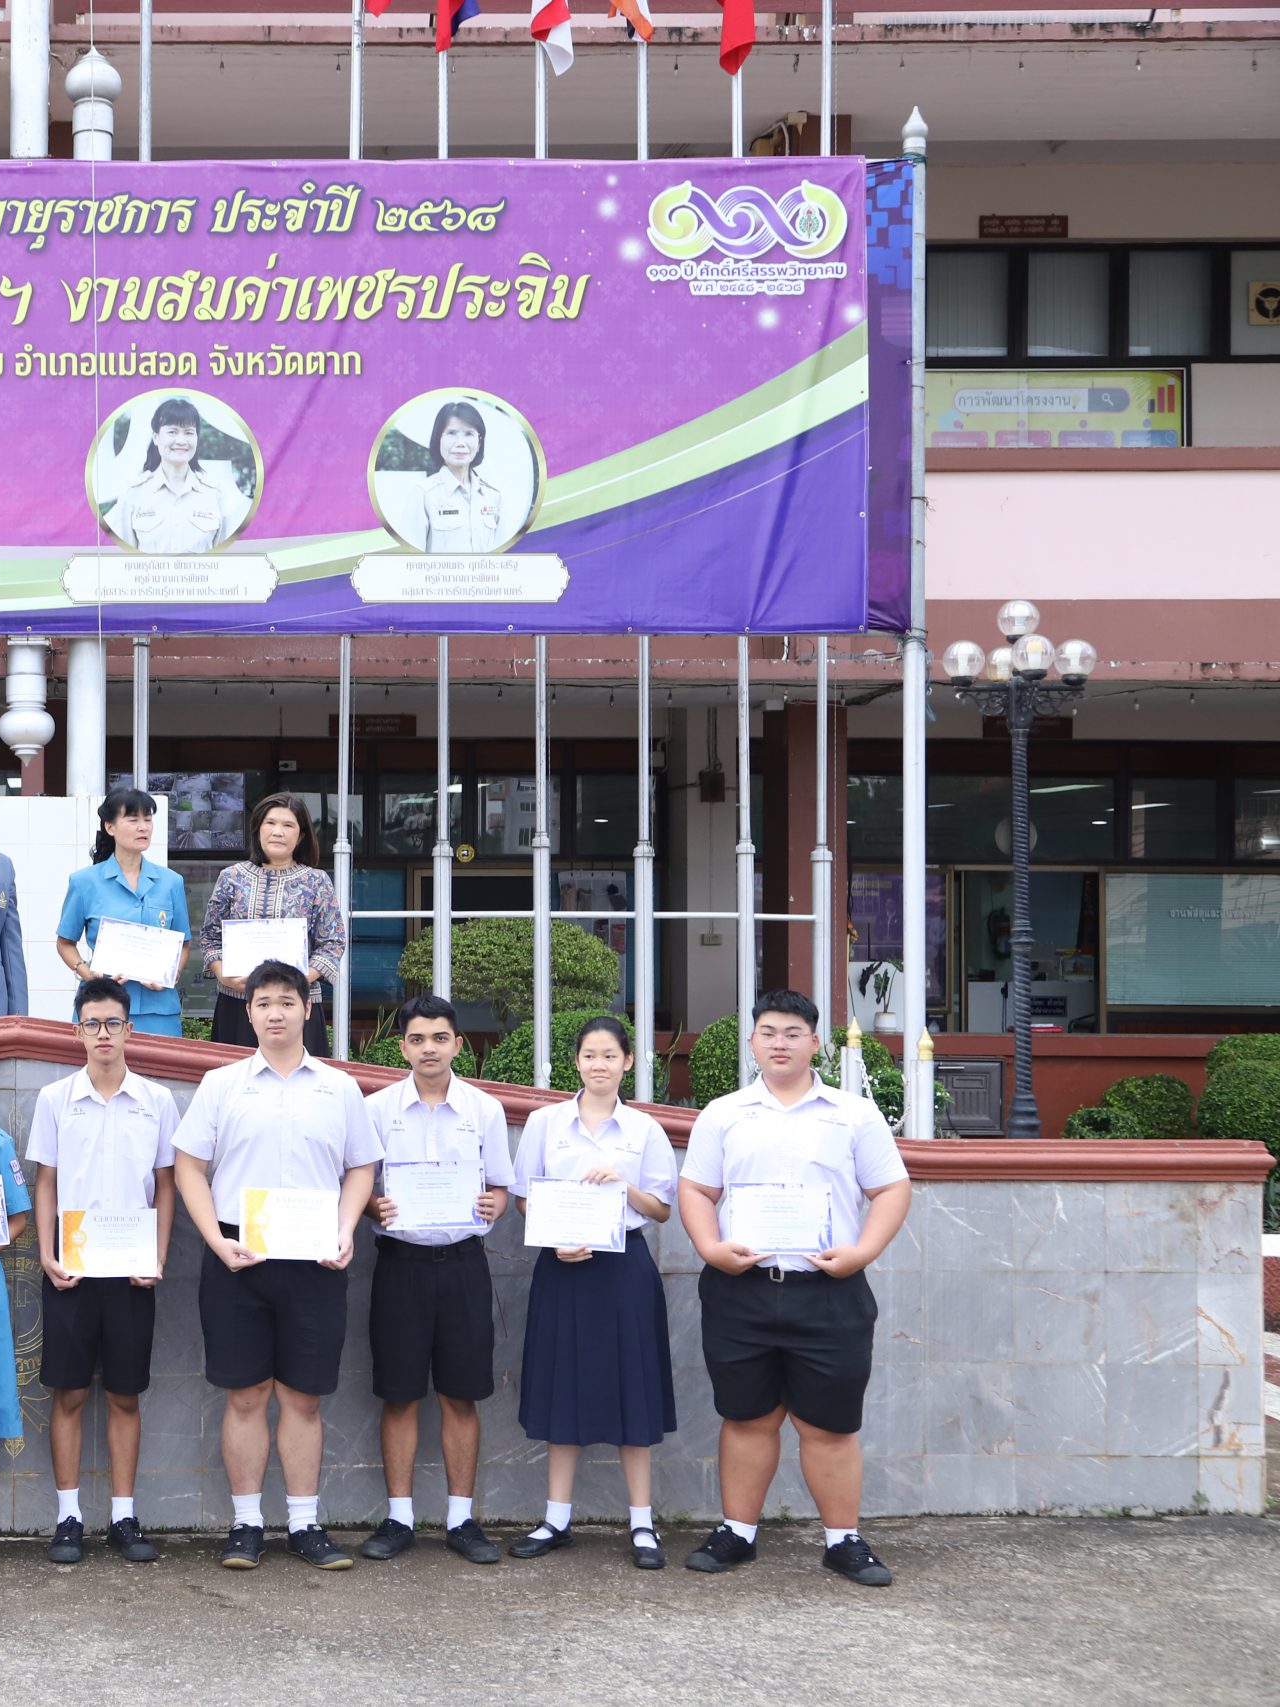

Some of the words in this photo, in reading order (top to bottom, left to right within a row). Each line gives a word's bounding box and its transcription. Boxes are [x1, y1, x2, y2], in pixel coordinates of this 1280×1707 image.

[212, 181, 359, 233] ประจำปี
[374, 198, 505, 233] ๒๕๖๘
[61, 252, 592, 322] งามสมค่าเพชรประจิม
[683, 264, 694, 277] ปี
[15, 345, 198, 377] อำเภอแม่สอด
[210, 343, 362, 377] จังหวัดตาก
[957, 391, 1072, 407] การพัฒนาโครงงาน
